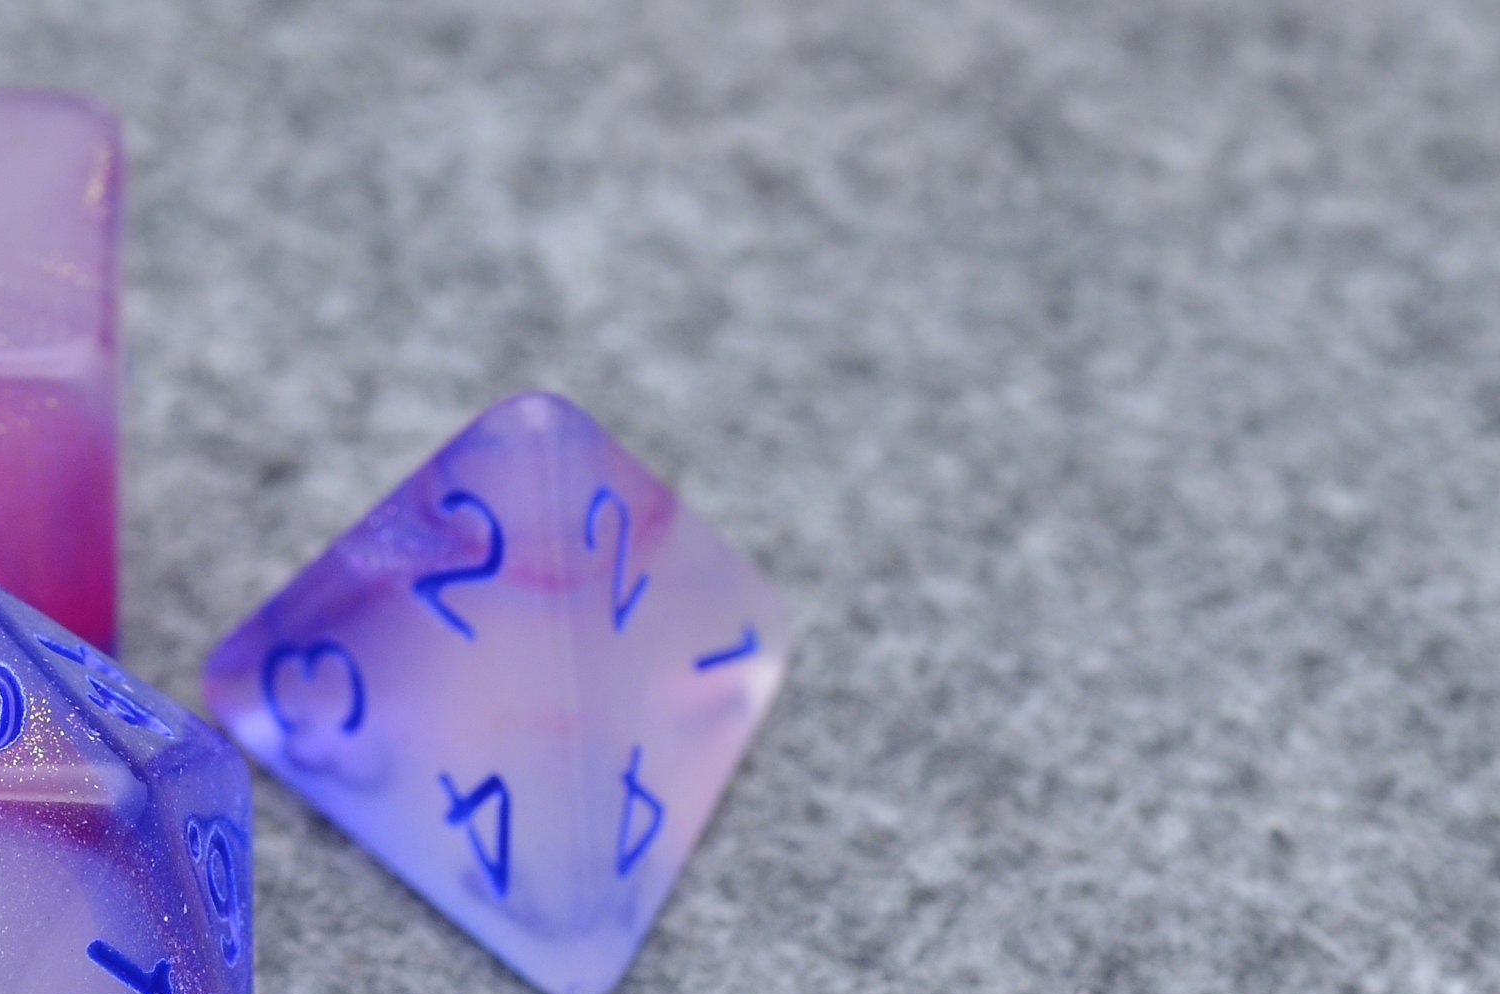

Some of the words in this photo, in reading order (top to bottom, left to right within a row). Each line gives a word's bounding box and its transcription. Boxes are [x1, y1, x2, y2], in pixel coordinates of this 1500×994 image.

[413, 490, 503, 641] 2
[585, 487, 649, 633] 2
[260, 640, 365, 734] 3
[694, 625, 759, 670] 1
[439, 773, 509, 898] 4
[617, 745, 663, 878] 4
